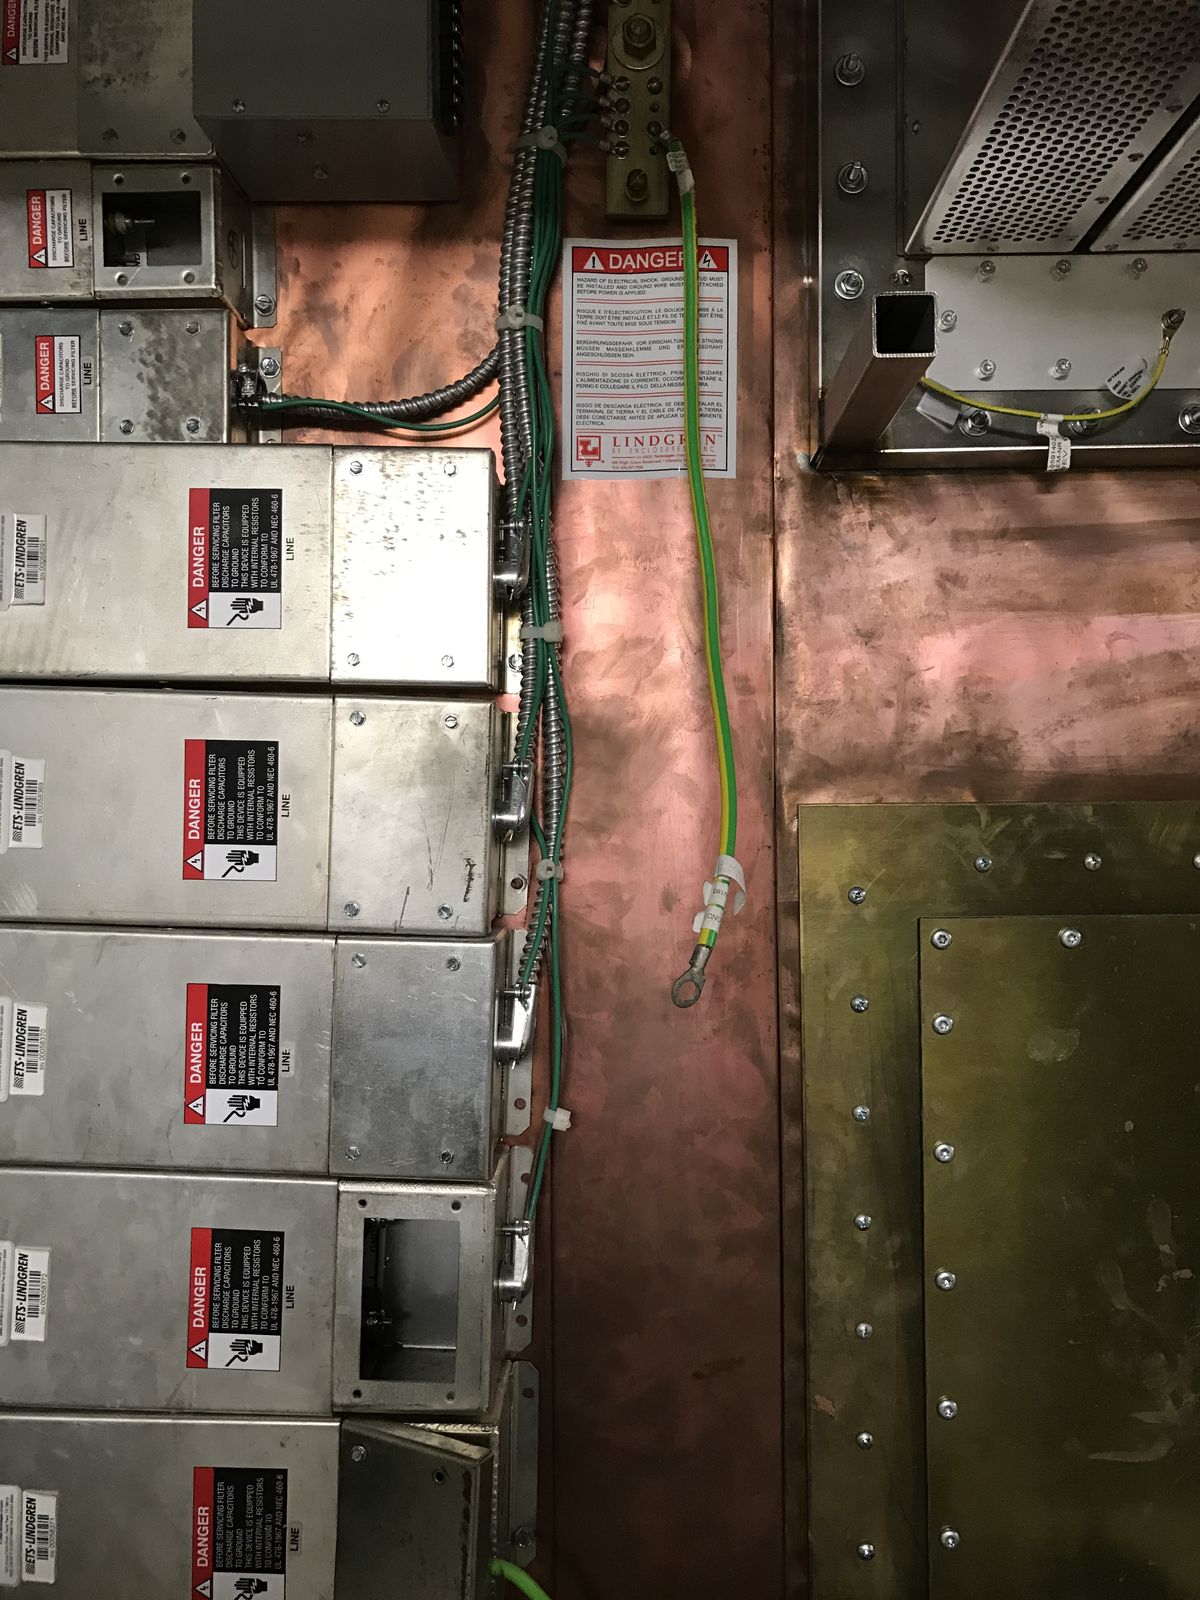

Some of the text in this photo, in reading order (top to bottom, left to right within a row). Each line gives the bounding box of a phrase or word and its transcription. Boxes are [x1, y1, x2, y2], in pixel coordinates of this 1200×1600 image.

[32, 196, 42, 244] DANGER
[79, 219, 87, 241] LINE
[609, 252, 684, 269] DANGE
[40, 343, 49, 390] DANGER
[222, 506, 230, 547] CAPACITORS
[261, 533, 268, 541] TO
[212, 525, 220, 560] SERVICING
[286, 538, 294, 560] LINE
[193, 527, 204, 587] DANGER
[232, 579, 239, 587] TO
[261, 579, 267, 588] TO
[271, 580, 278, 588] UL
[257, 786, 264, 794] TO
[188, 779, 200, 840] DANGER
[281, 794, 290, 817] LINE
[207, 815, 215, 840] BEFORE
[227, 831, 234, 840] TO
[256, 832, 263, 840] TO
[266, 832, 273, 840] UL
[269, 990, 277, 1009] 460-6
[249, 993, 257, 1031] RESISTORS
[259, 1030, 266, 1038] TO
[190, 1022, 201, 1084] DANGER
[248, 1034, 256, 1066] INTERNAL
[282, 1049, 290, 1072] LINE
[229, 1076, 235, 1084] TO
[257, 1077, 264, 1085] TO
[267, 1077, 274, 1085] UL
[193, 1266, 205, 1328] DANGER
[286, 1286, 294, 1309] LINE
[197, 1506, 208, 1567] DANGER
[290, 1528, 299, 1551] LINE
